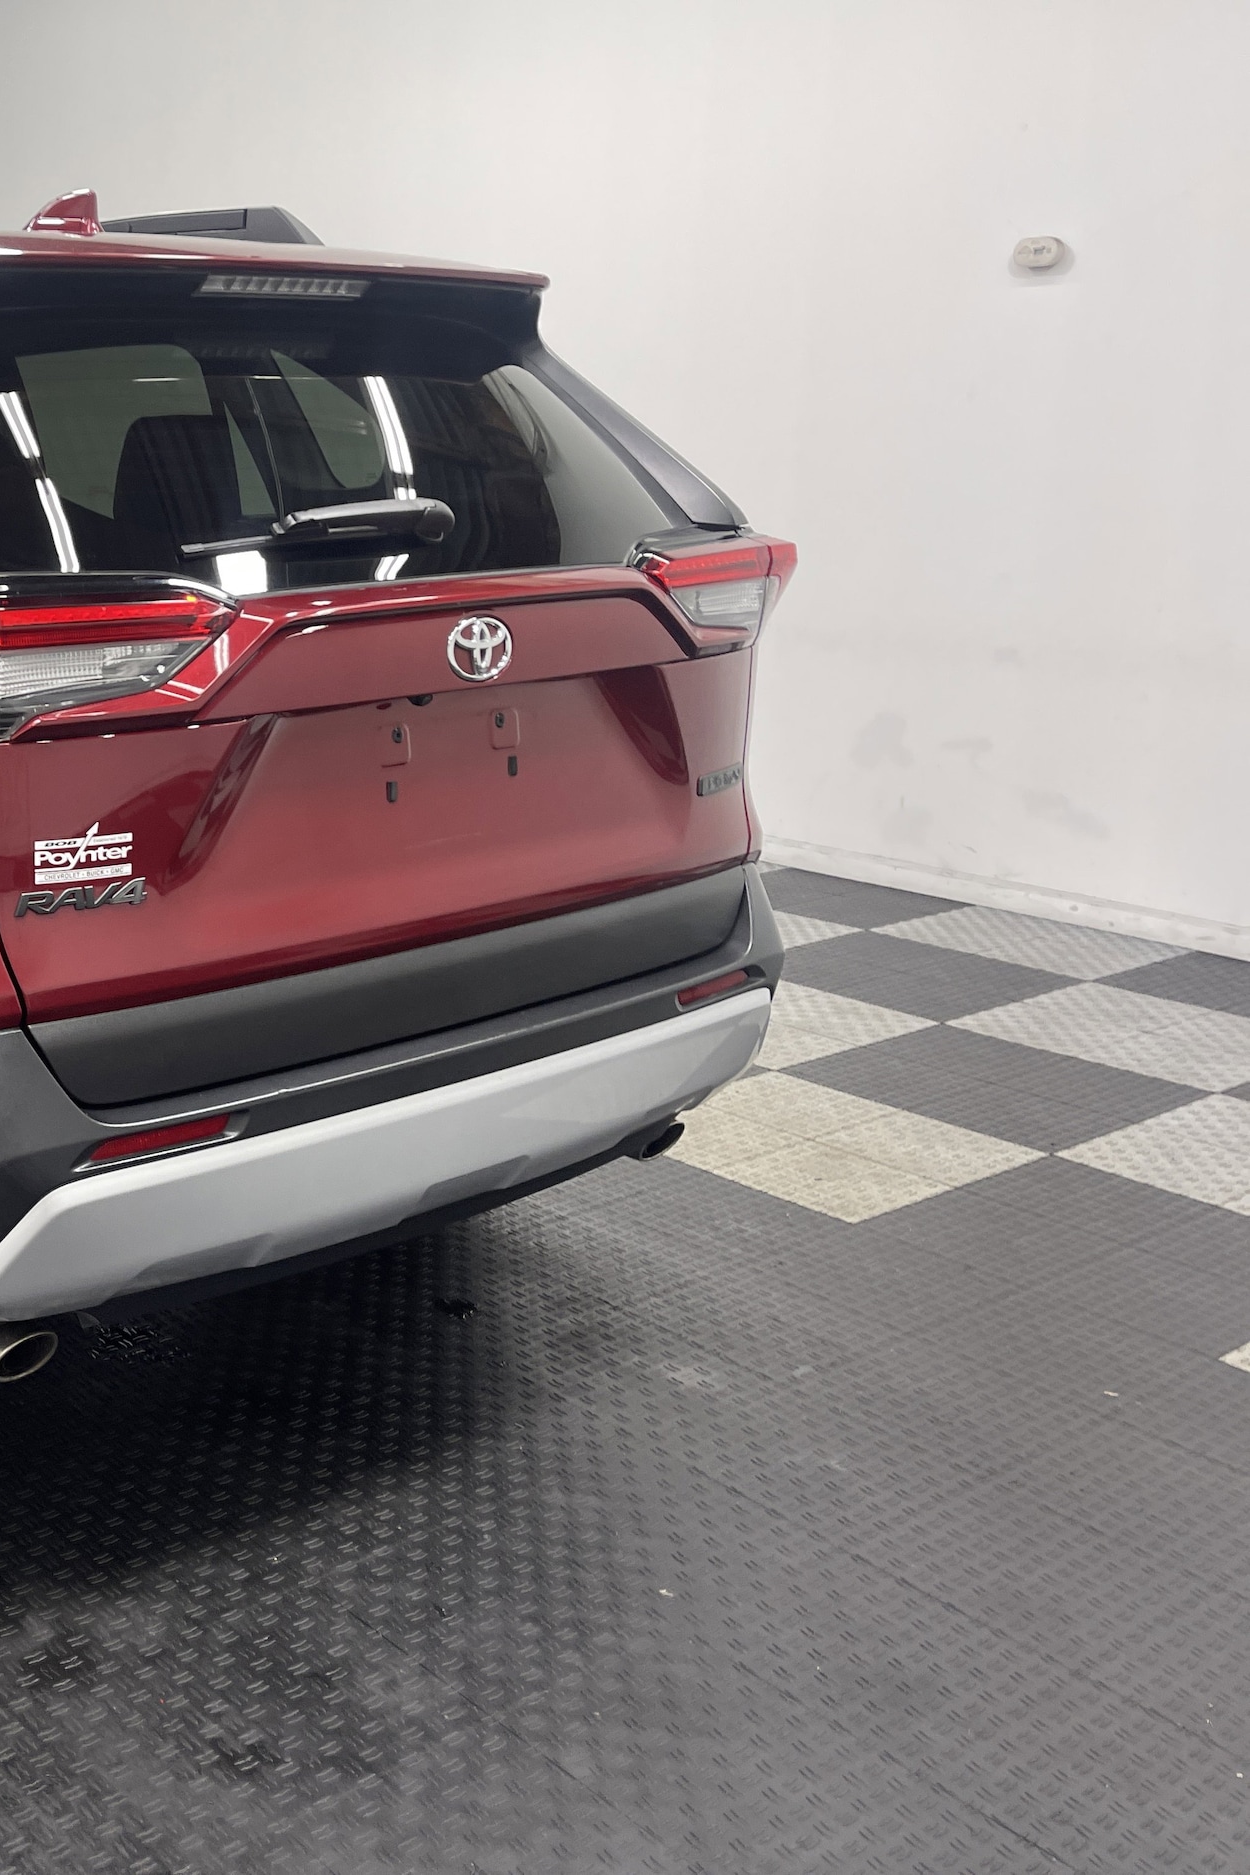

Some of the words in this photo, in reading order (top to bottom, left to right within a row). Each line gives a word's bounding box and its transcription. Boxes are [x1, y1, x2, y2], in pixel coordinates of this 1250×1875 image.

[34, 845, 133, 869] Poynter
[44, 872, 80, 881] CHEVROLET
[86, 869, 105, 877] BUICK
[14, 877, 147, 917] RAV4
